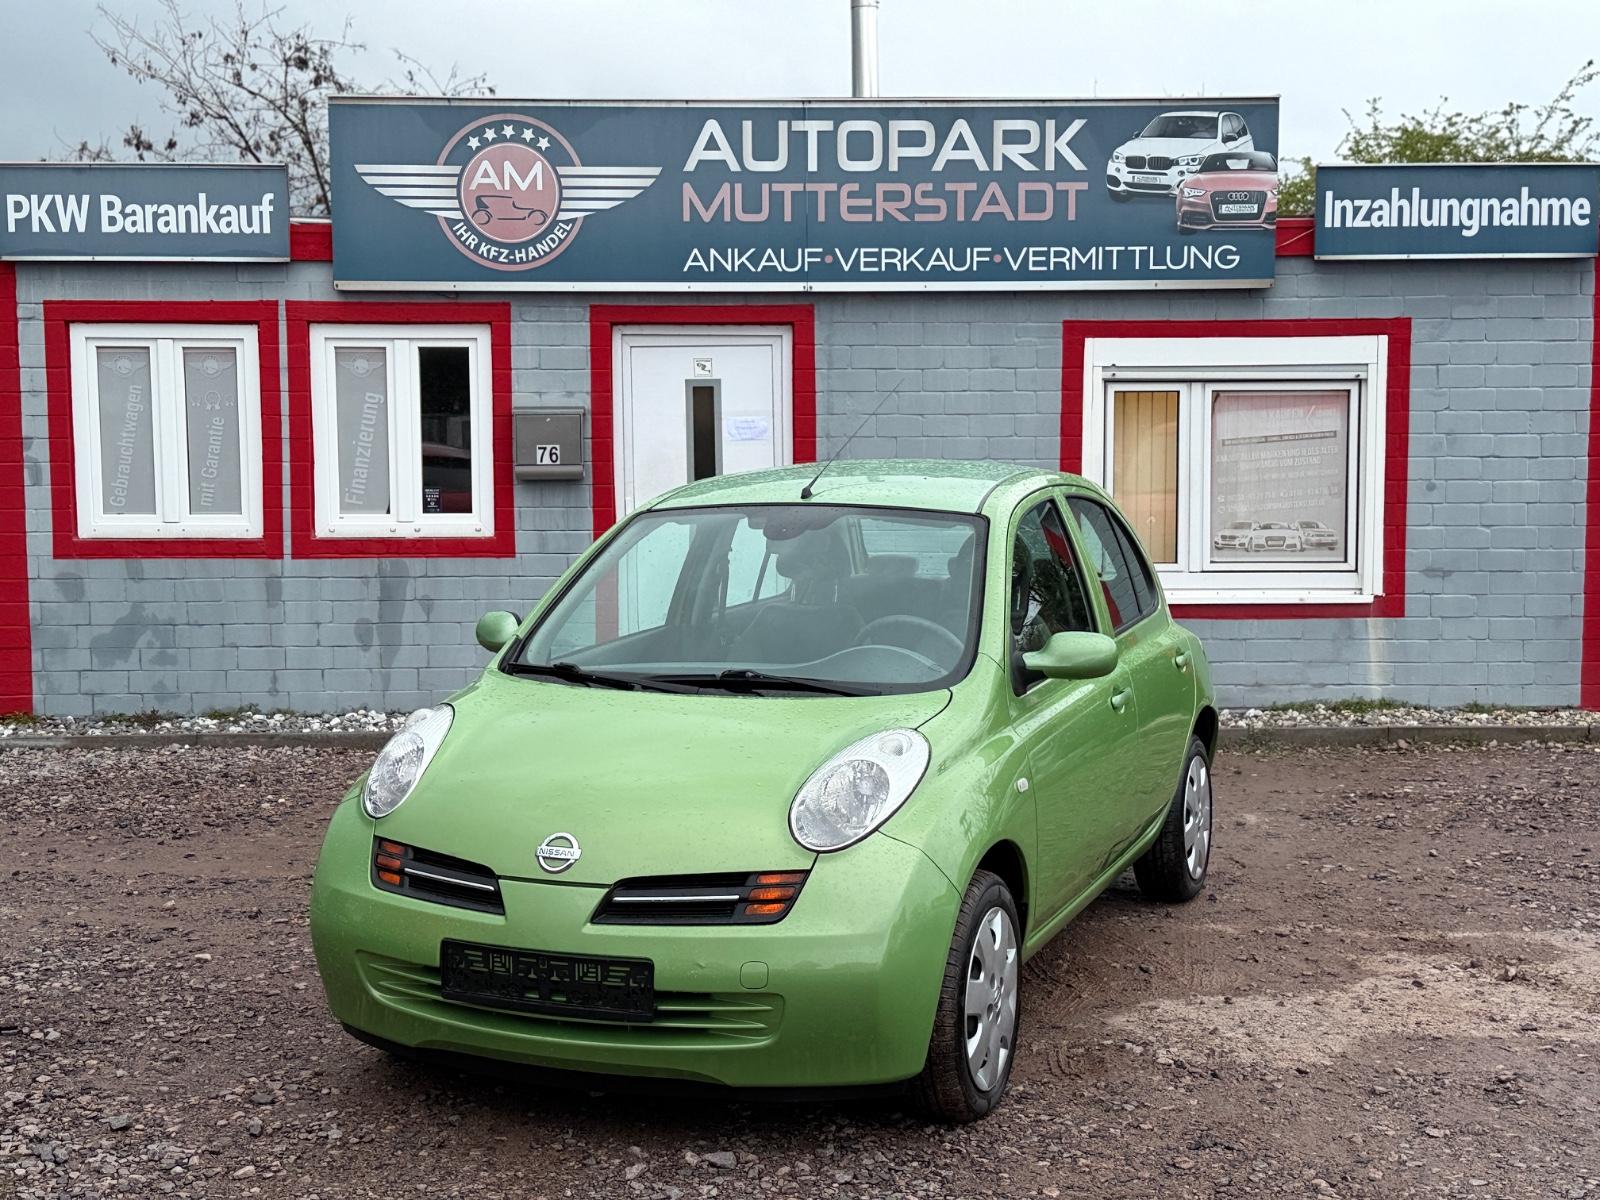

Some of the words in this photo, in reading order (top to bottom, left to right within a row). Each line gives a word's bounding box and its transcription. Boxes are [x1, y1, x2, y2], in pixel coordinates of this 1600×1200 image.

[683, 118, 1088, 172] AUTOPARK
[469, 160, 543, 192] AM
[6, 193, 91, 233] PKW
[99, 192, 275, 235] Barankauf
[683, 181, 1089, 223] MUTTERSTADT
[1324, 186, 1591, 237] Inzahlungnahme
[452, 221, 479, 250] IHR
[478, 221, 573, 263] KFZ-HANDEL
[682, 247, 824, 273] ANKAUF
[834, 246, 992, 272] VERKAUF
[1003, 244, 1241, 271] VERMITTLUNG
[110, 384, 144, 508] Gebrauchtwagen
[201, 416, 225, 479] Garantie
[344, 391, 385, 505] Finanzierung
[537, 446, 559, 464] 76
[197, 482, 215, 507] mit
[538, 847, 575, 857] NISSAN
